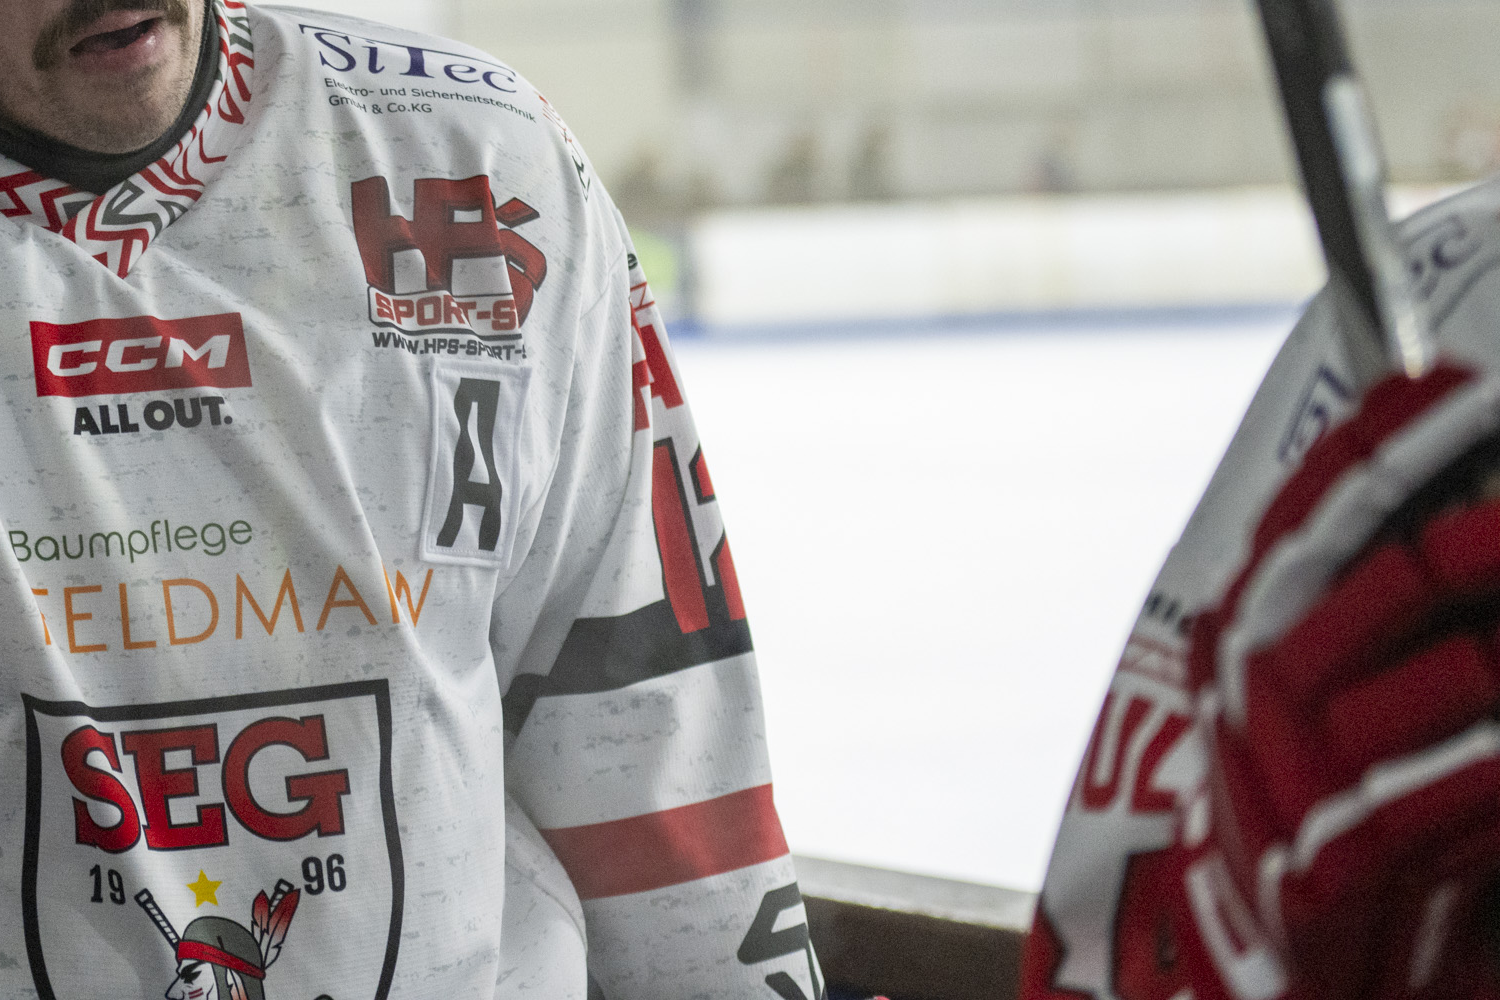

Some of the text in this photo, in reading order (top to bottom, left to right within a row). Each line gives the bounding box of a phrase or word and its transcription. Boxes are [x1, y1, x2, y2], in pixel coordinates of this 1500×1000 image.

[299, 24, 518, 94] SiTec
[371, 103, 384, 114] &
[386, 102, 433, 114] Co.KG
[380, 87, 407, 97] und
[411, 88, 537, 123] Sicherheitstechnik
[46, 333, 231, 377] CCM
[73, 396, 234, 436] ALL OUT.
[436, 377, 503, 552] A
[8, 519, 253, 563] Baumpflege
[60, 713, 352, 855] SEG
[89, 852, 348, 906] 19 96
